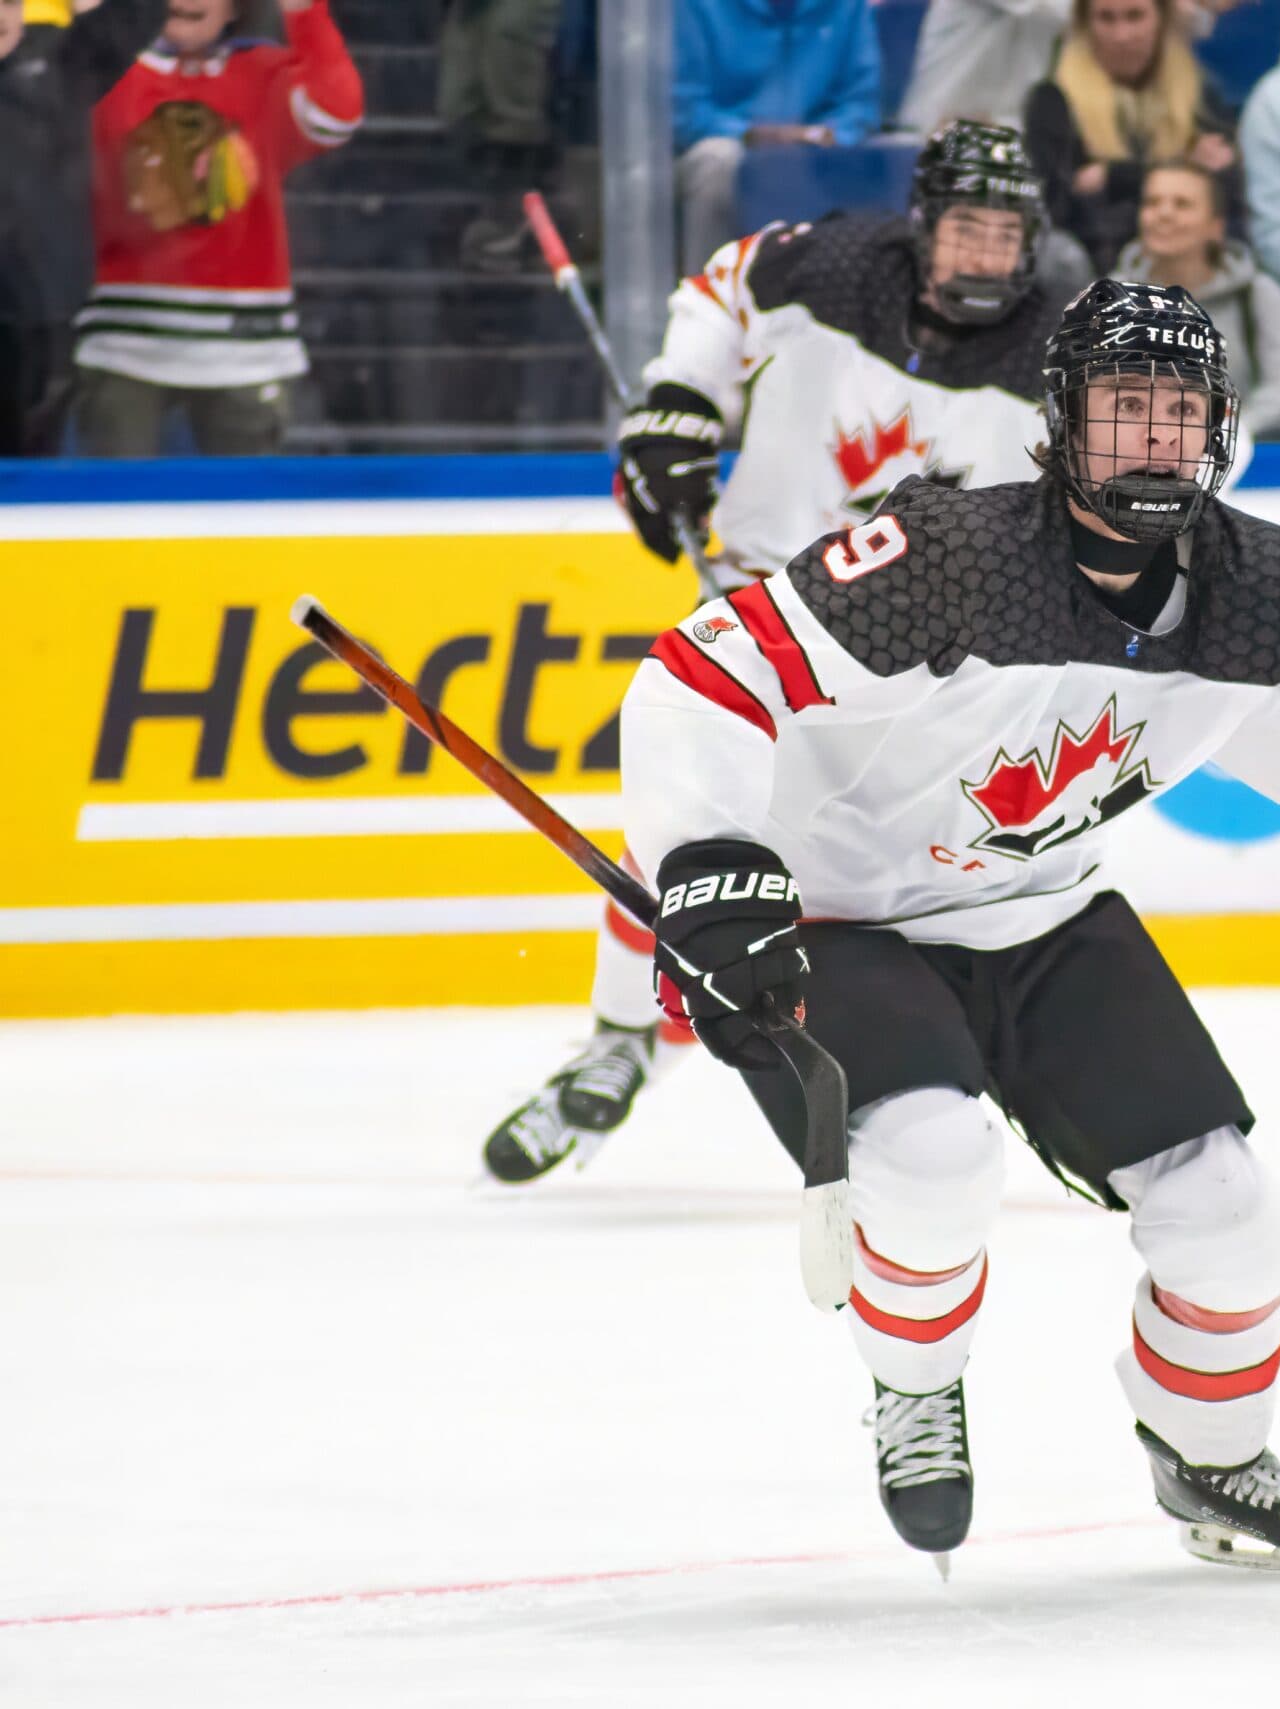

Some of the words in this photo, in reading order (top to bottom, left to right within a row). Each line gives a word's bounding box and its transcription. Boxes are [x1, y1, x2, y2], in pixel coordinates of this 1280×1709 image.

[1146, 326, 1216, 355] TELUS
[1131, 501, 1181, 512] BAUER
[822, 514, 908, 584] 9
[661, 872, 800, 918] BAUER
